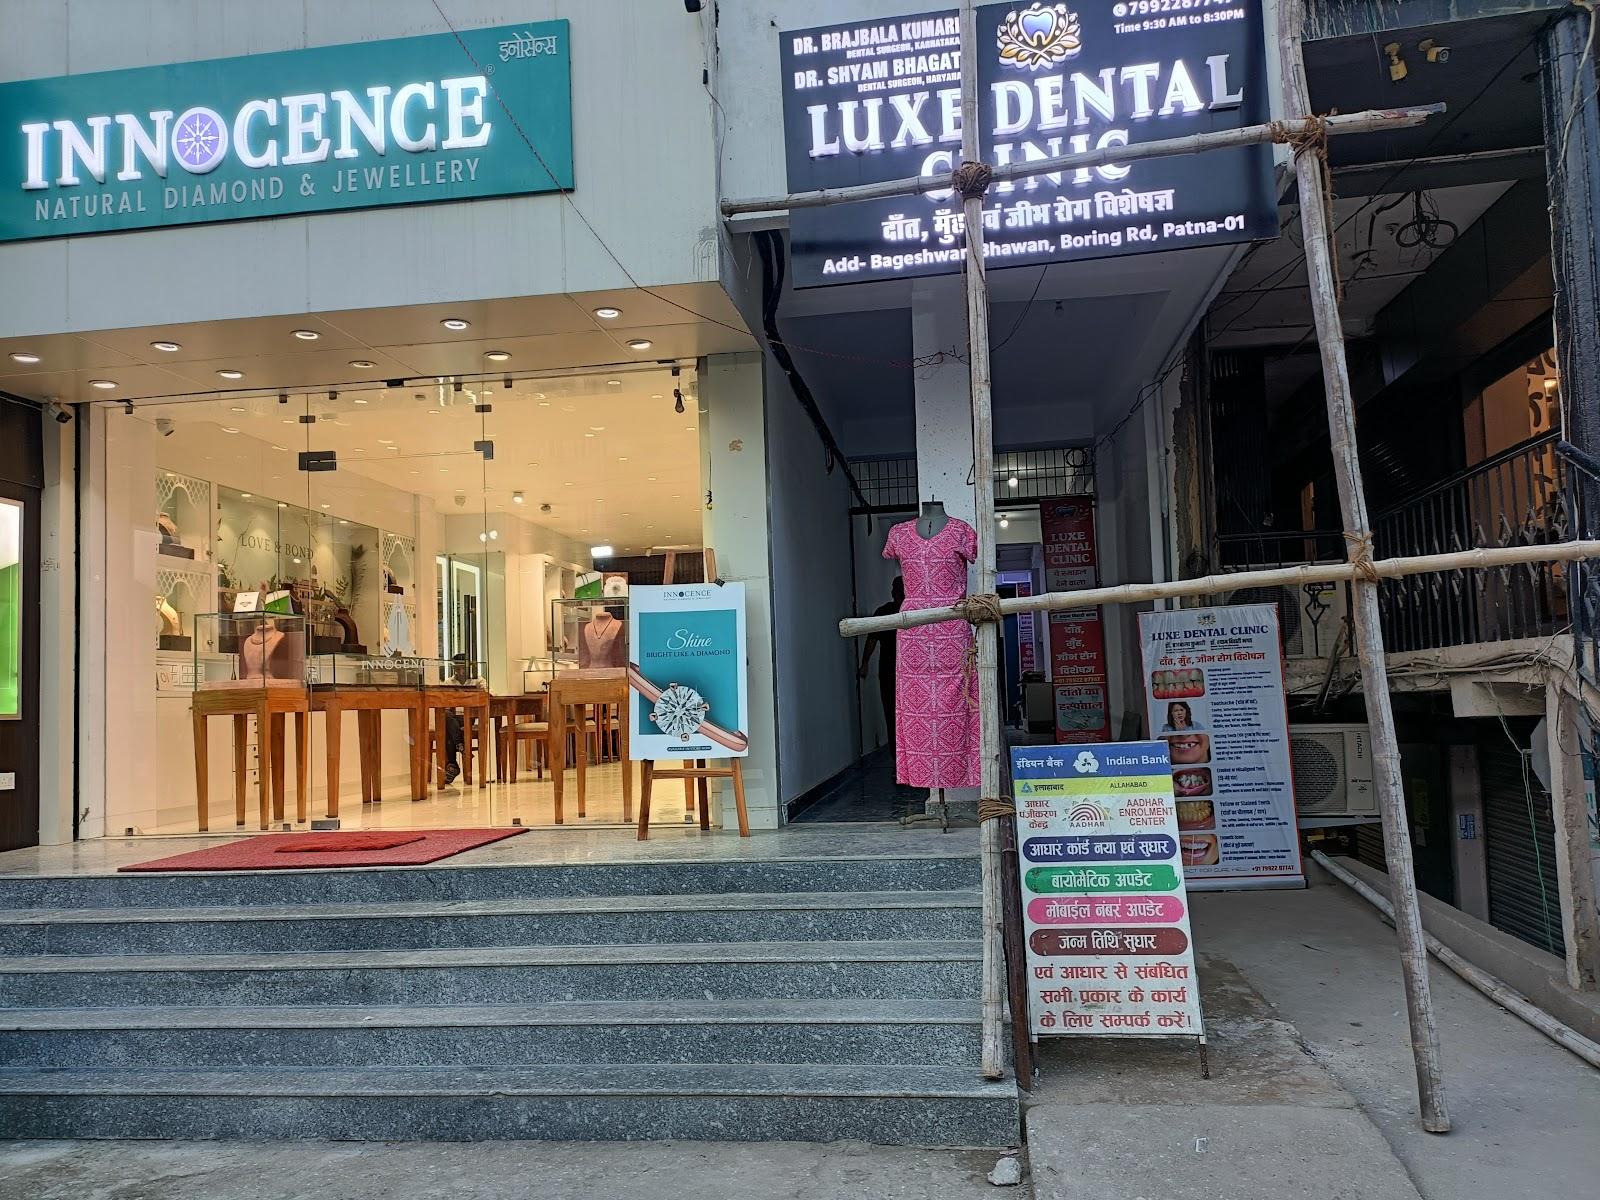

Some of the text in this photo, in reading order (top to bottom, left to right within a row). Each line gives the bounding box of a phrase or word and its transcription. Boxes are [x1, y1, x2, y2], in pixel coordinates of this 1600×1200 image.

[1129, 0, 1233, 15] 7992287
[1114, 8, 1245, 34] Time 9:30 AM to 8:30PM
[793, 16, 960, 56] DR. BRAJBALA KUMARI
[846, 49, 875, 59] DENTAL
[914, 36, 960, 49] KARNATAKA
[794, 51, 961, 90] DR. SHYAM BHAGAT
[857, 82, 887, 93] DENTAL
[926, 72, 962, 84] HARYANA
[806, 54, 1244, 158] LUXE DENTAL
[21, 76, 492, 190] INNOCENCE
[921, 129, 1132, 200] CINIC
[35, 158, 481, 221] NATURAL DIAMOND & JEWELLERY
[1004, 200, 1051, 228] जीभ
[1054, 196, 1092, 222] रोग
[1094, 188, 1175, 218] विशेषज्ञ
[822, 255, 867, 274] Add-
[1060, 230, 1122, 249] Boring
[1127, 225, 1158, 242] Rd,
[1163, 214, 1245, 238] Patna-01
[1051, 532, 1086, 541] LUXE
[241, 533, 314, 560] LOVE & BOND
[1045, 542, 1092, 553] DENTAL
[1051, 554, 1091, 564] CLINIC
[666, 628, 713, 650] Shine
[1152, 625, 1268, 640] LUXE DENTAL CLINIC
[1217, 652, 1232, 662] रोग
[1234, 651, 1265, 661] विशेषज्ञ
[1015, 756, 1064, 769] इंडियन बैंक
[1106, 754, 1169, 766] Indian Bank
[1033, 783, 1065, 792] इलाहाबाद
[1025, 800, 1050, 808] आधार
[1126, 798, 1164, 807] AADHAR
[1119, 807, 1173, 817] ENROLMENT
[1129, 817, 1166, 826] CENTER
[1093, 842, 1116, 854] नया
[1120, 838, 1135, 855] एवं
[1138, 840, 1169, 857] सुधार
[1115, 869, 1153, 887] अपडेट
[1045, 900, 1091, 918] मोबाईल
[1126, 900, 1164, 917] अपडेट
[1059, 931, 1157, 952] जन्म तिथि सुधार
[1034, 962, 1189, 979] एवं आधार से संबंधित
[1040, 986, 1187, 1005] सभी प्रकार के कार्य
[1040, 1011, 1056, 1027] के
[1063, 1011, 1094, 1027] लिए
[1100, 1011, 1150, 1028] सम्पर्क
